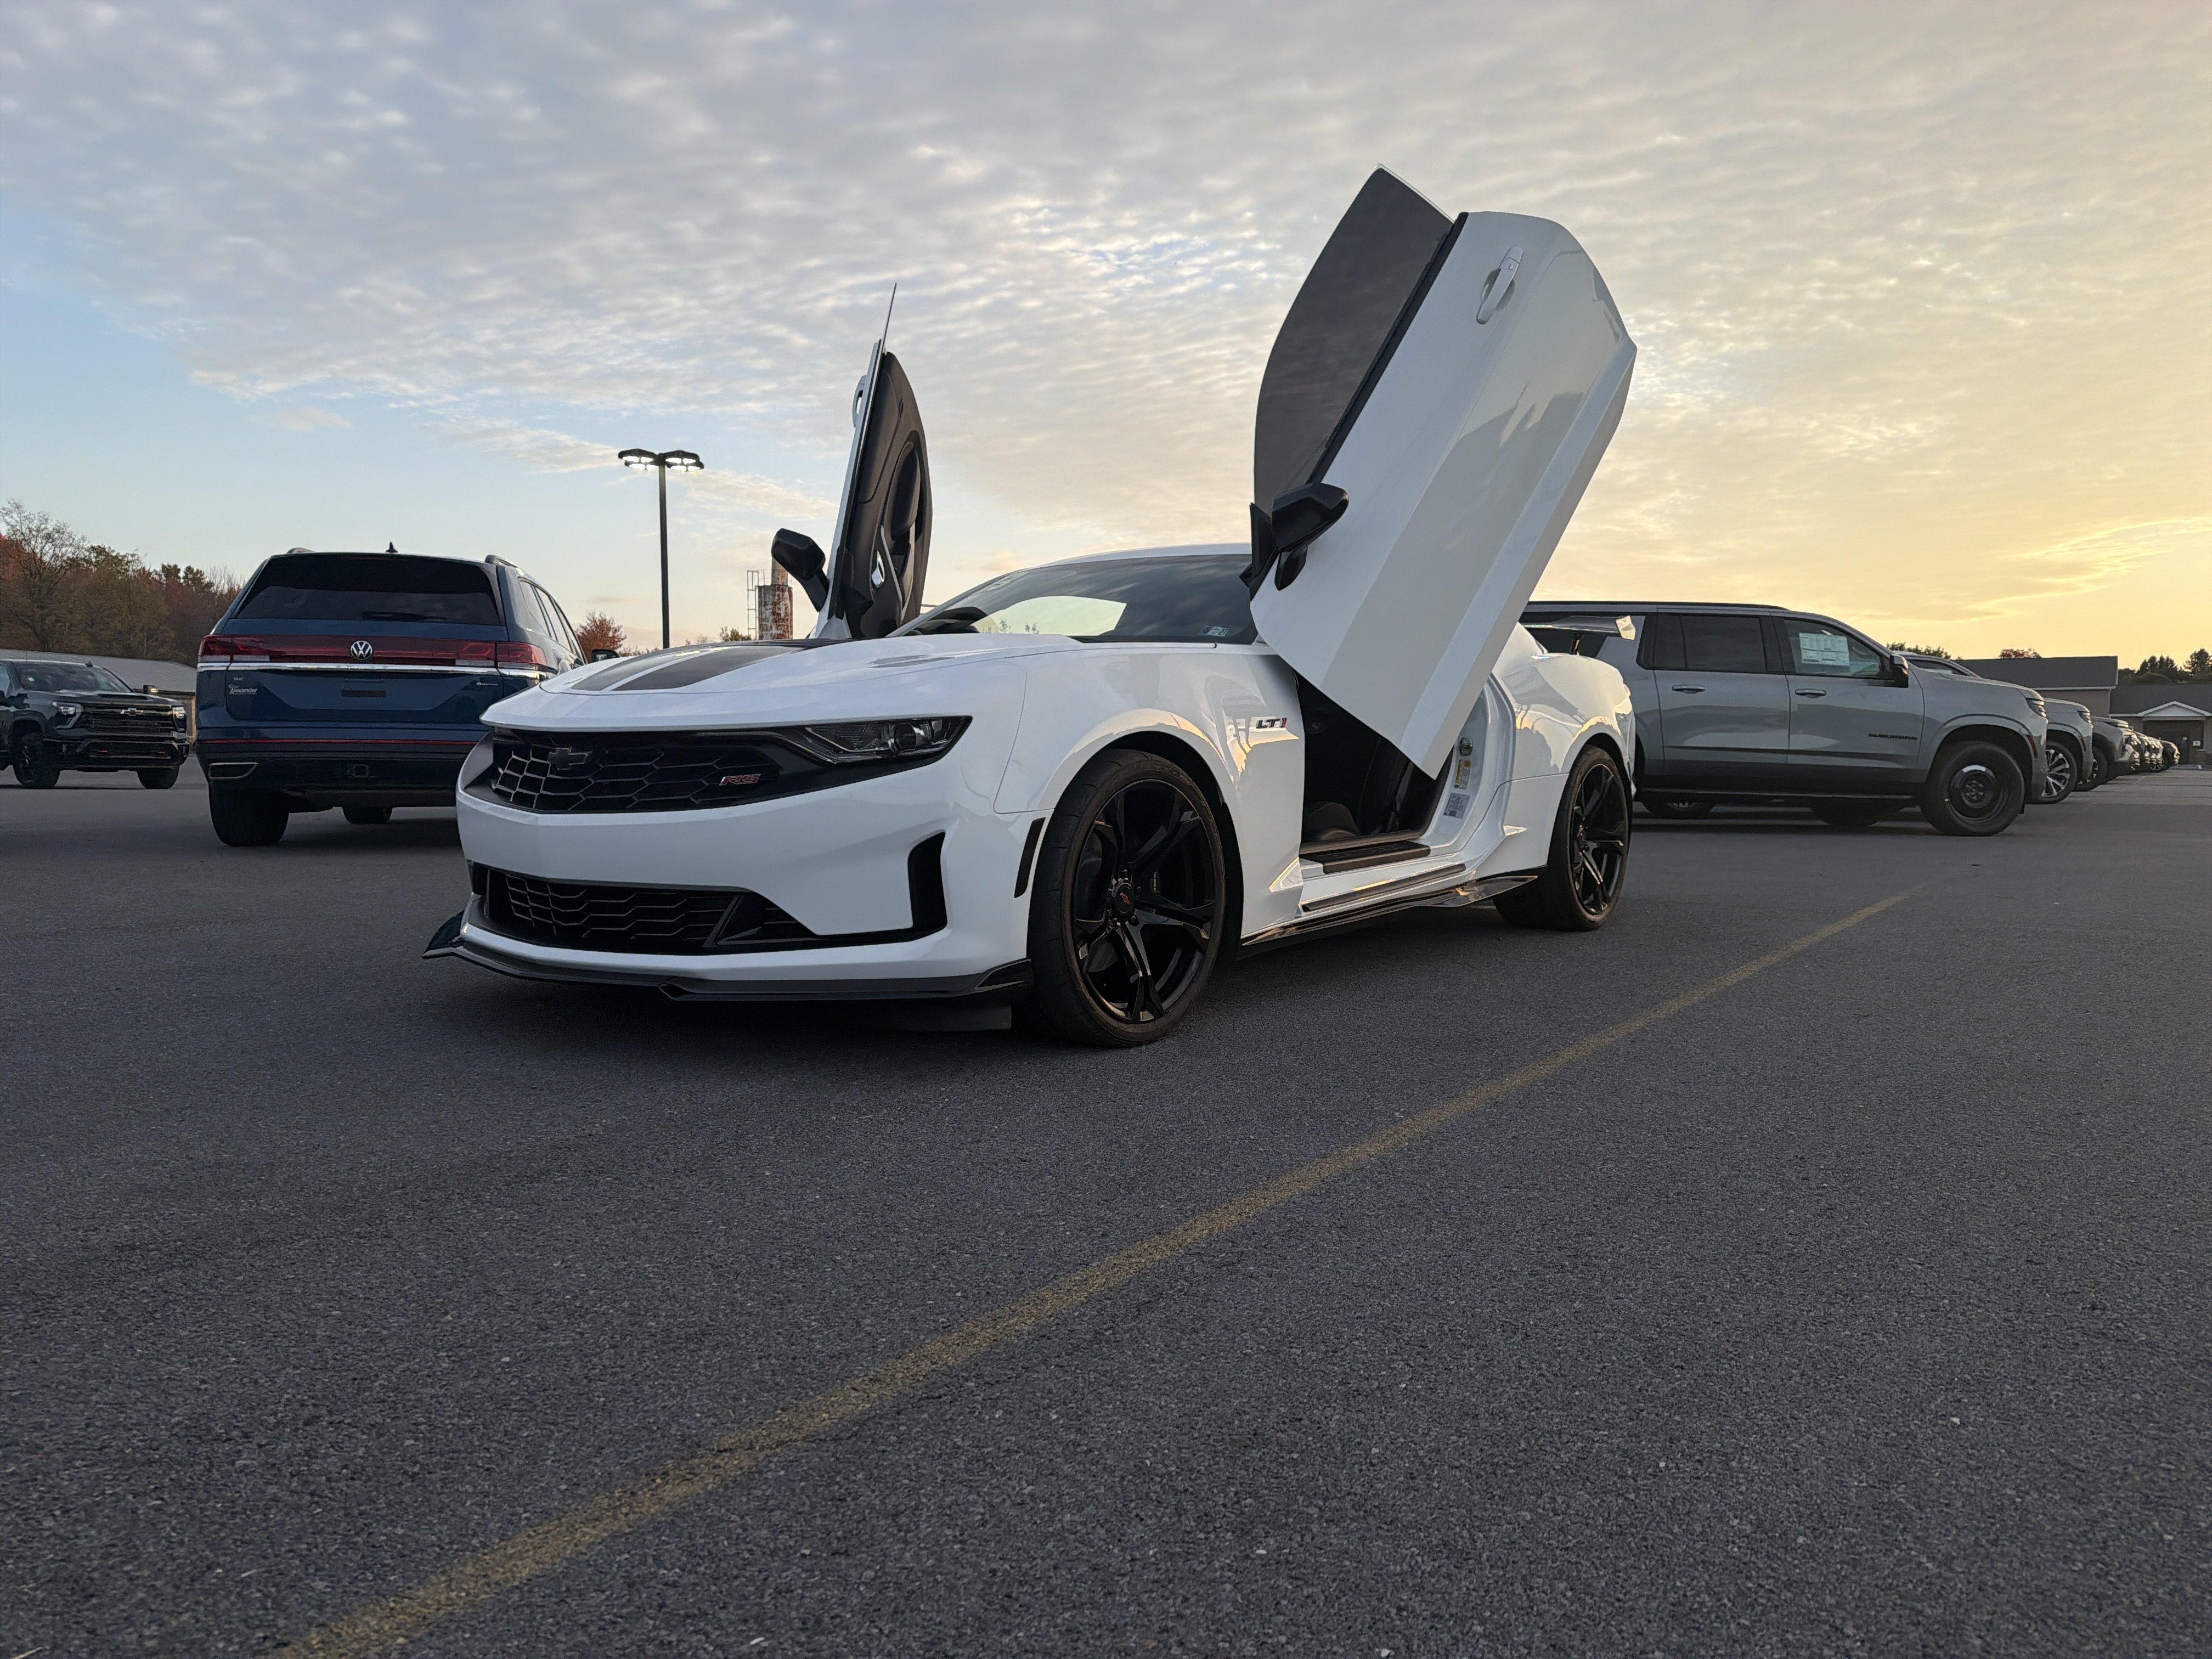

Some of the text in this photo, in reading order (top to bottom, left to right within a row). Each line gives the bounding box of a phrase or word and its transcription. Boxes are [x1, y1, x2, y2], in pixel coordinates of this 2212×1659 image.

[229, 687, 258, 695] Alexander
[1256, 717, 1288, 729] LT1
[719, 773, 761, 786] RS
